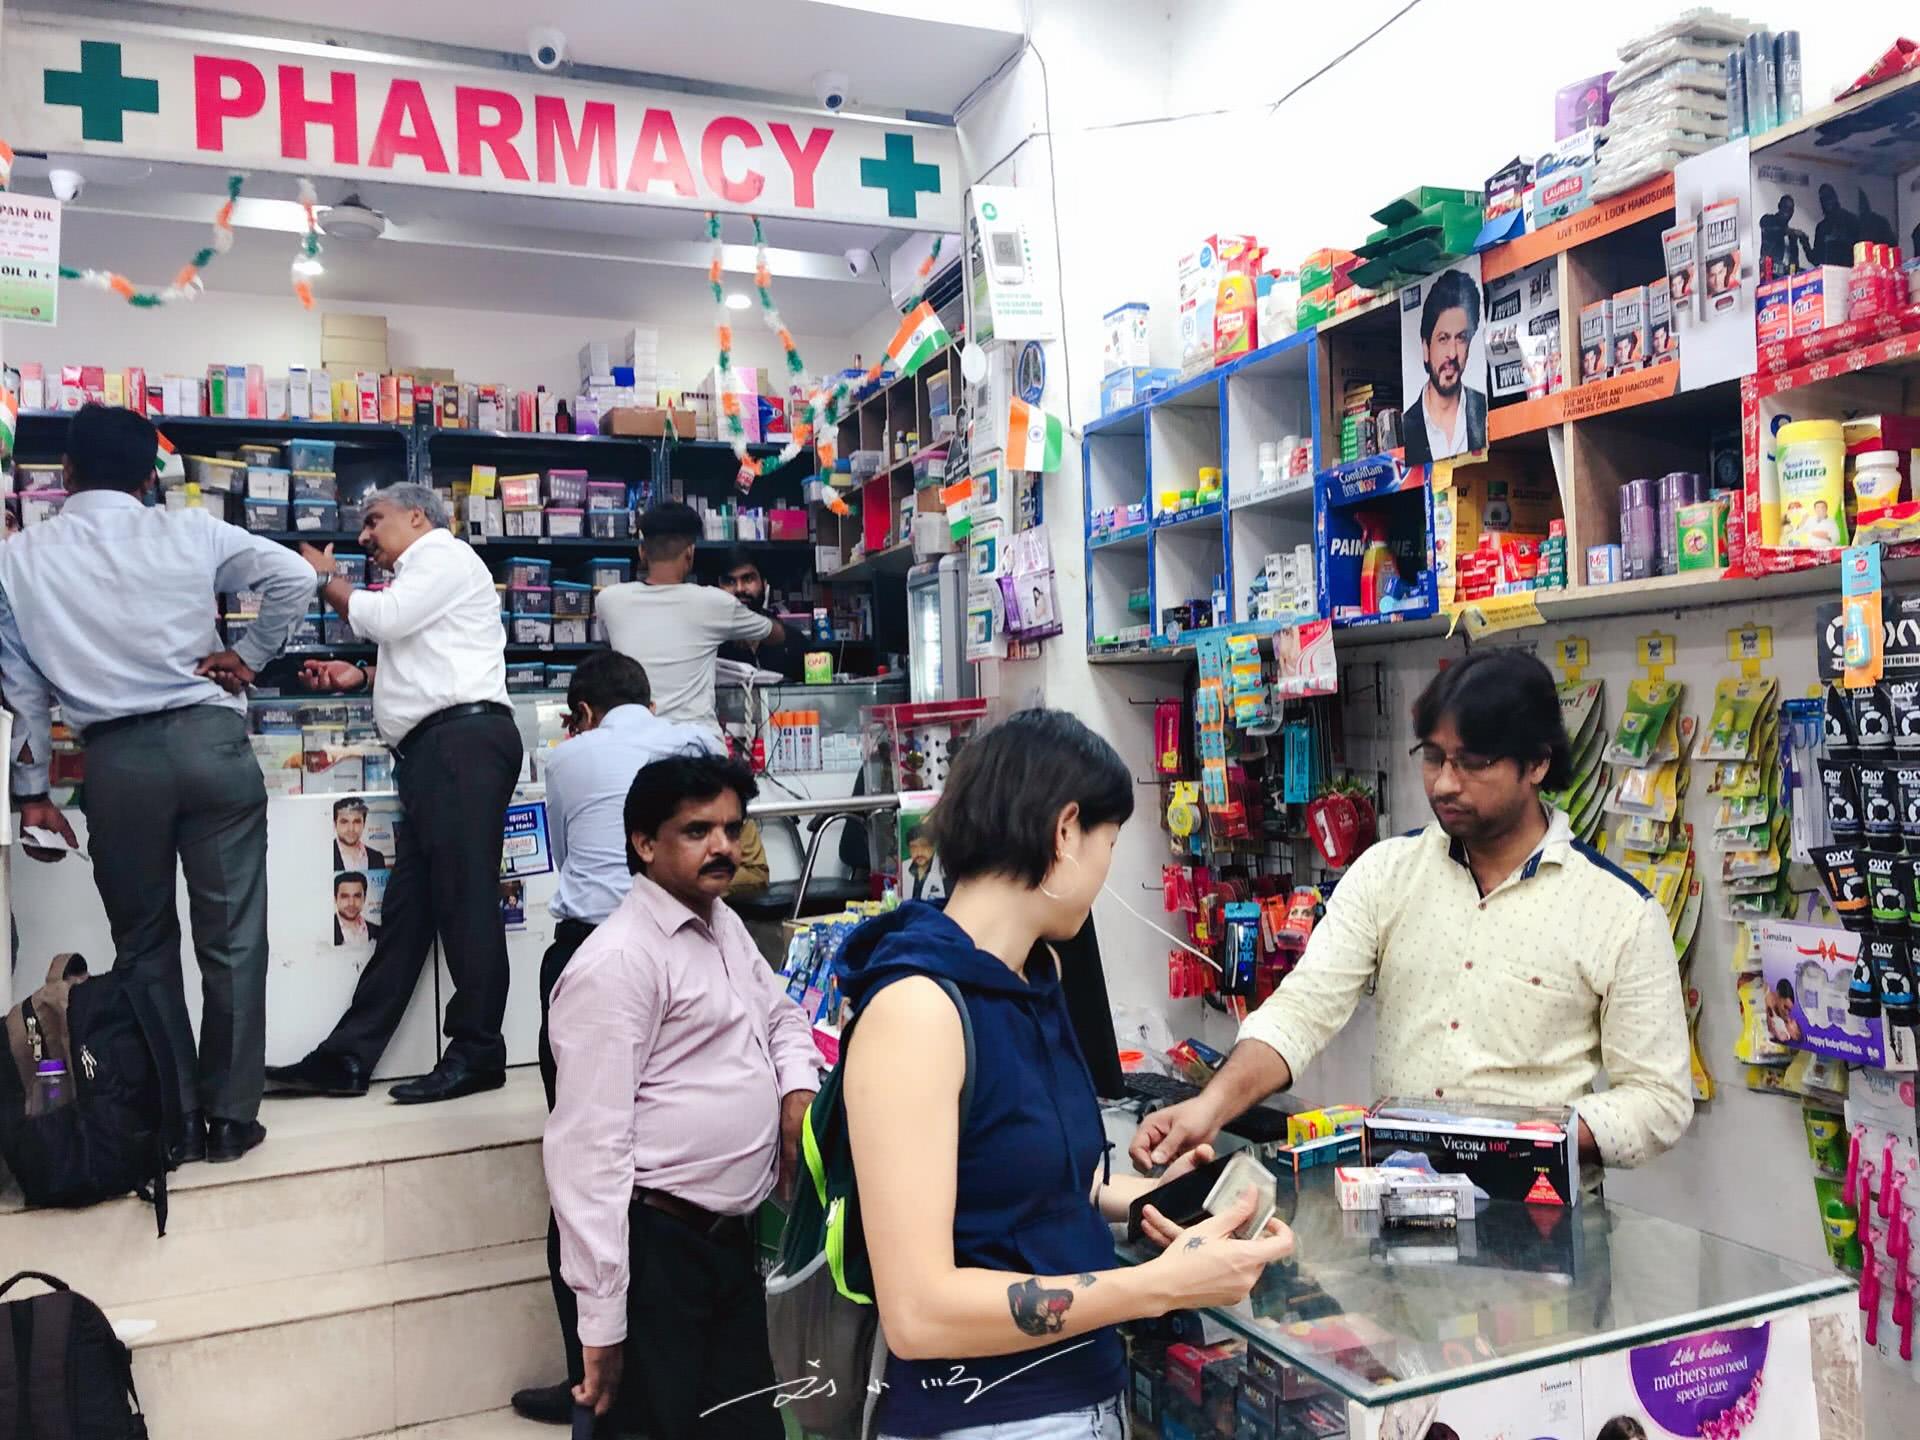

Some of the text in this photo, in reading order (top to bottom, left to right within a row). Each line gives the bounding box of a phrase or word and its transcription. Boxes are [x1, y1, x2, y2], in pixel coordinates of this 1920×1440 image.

[193, 54, 834, 208] PHARMACY
[1544, 177, 1581, 200] LAURELS
[0, 205, 53, 221] PAIN OIL
[1557, 229, 1574, 241] LIVE
[1605, 203, 1627, 222] LOOK
[1, 266, 22, 277] OIL
[1610, 386, 1624, 396] AND
[1625, 376, 1665, 393] HANDSOME
[1596, 395, 1620, 409] CREAM
[1805, 458, 1821, 467] Free
[1338, 465, 1384, 485] Combiflam
[1783, 466, 1827, 482] Natura
[1330, 538, 1365, 556] PAIN
[1894, 656, 1905, 665] FOR
[1891, 682, 1919, 695] OXY
[1824, 769, 1842, 780] OXY
[1861, 769, 1885, 780] OXY
[1825, 849, 1854, 863] OXY
[1868, 859, 1893, 870] OXY
[1871, 942, 1894, 954] OXY
[1239, 951, 1254, 962] nic
[1488, 1141, 1507, 1153] 100
[1669, 1345, 1696, 1367] Like
[1653, 1355, 1748, 1392] mothers too need
[1675, 1379, 1729, 1405] special care
